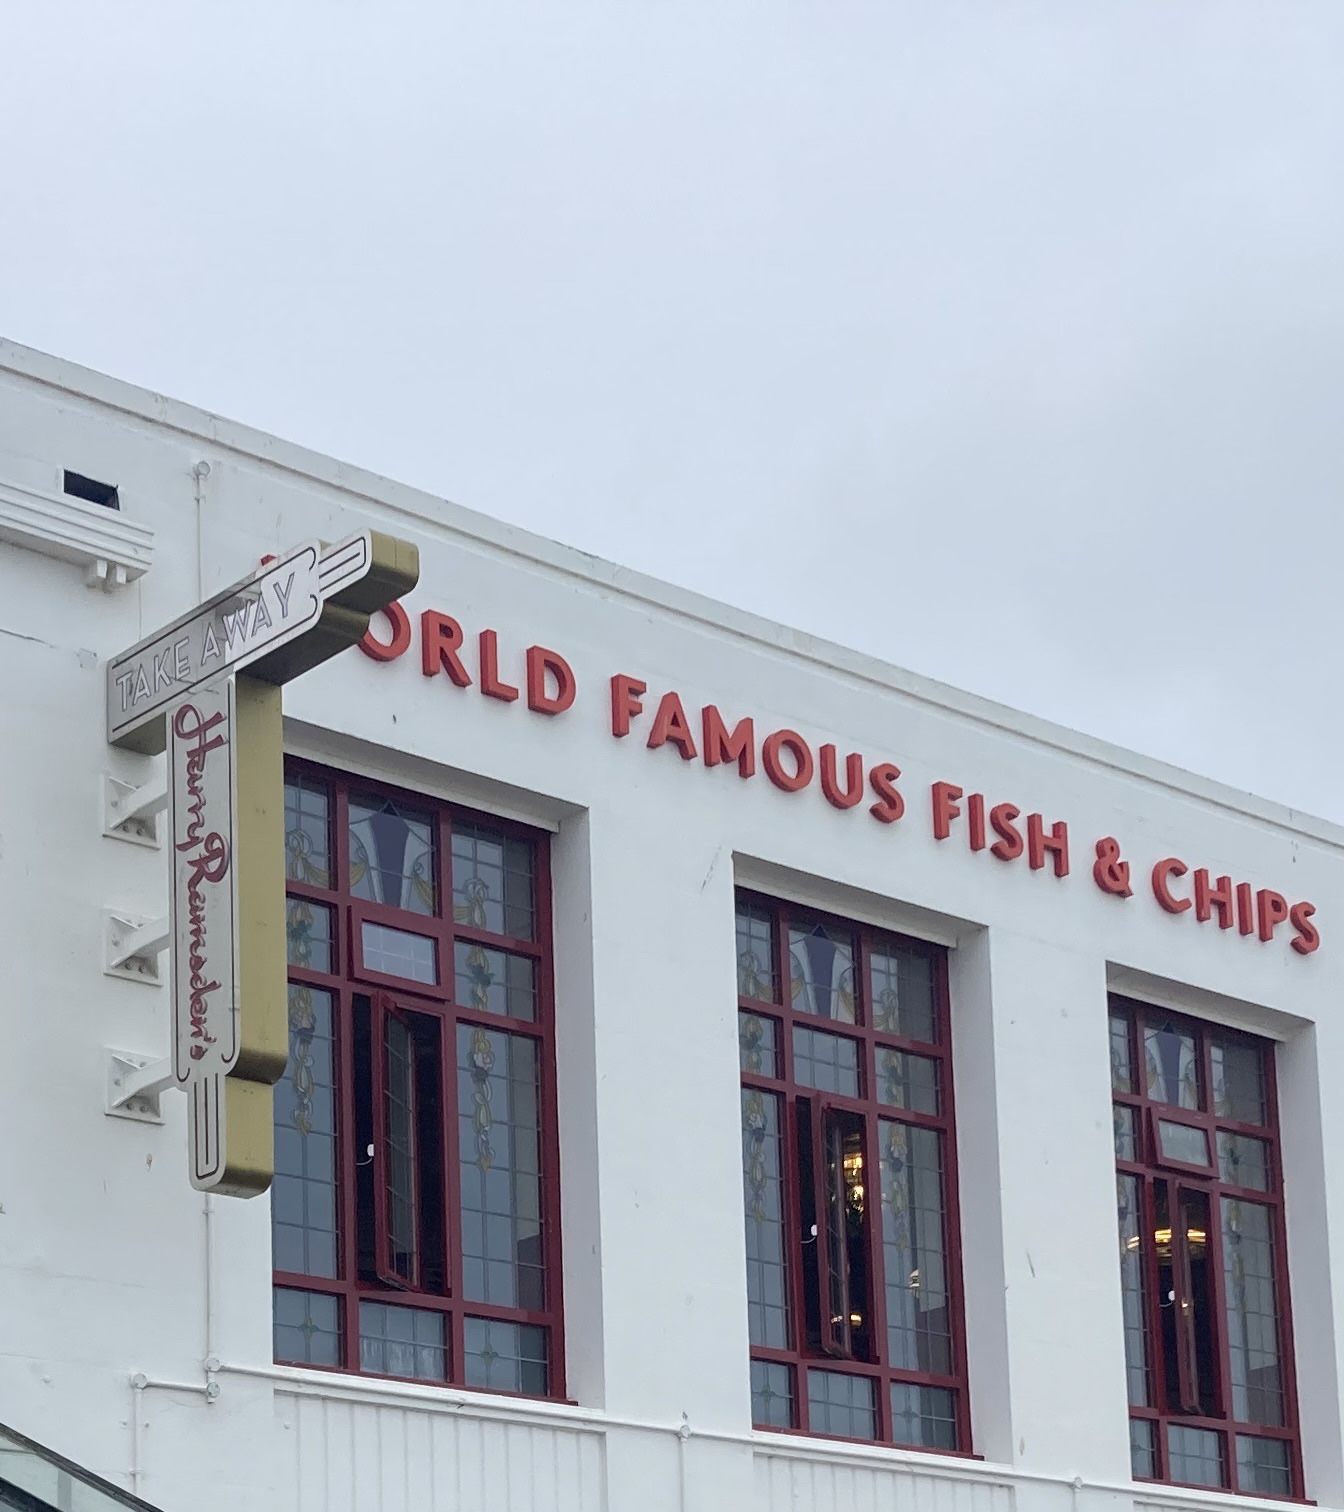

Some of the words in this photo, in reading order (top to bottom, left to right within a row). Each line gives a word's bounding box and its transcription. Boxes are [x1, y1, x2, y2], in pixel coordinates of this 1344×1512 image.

[115, 637, 191, 713] TAKE
[200, 571, 296, 667] AWAY
[174, 703, 229, 852] Harry
[610, 673, 905, 825] FAMOUS
[931, 781, 1070, 878] FISH
[1093, 836, 1134, 899] &
[1151, 857, 1320, 956] CHIPS
[186, 832, 230, 1062] Ramsden's
